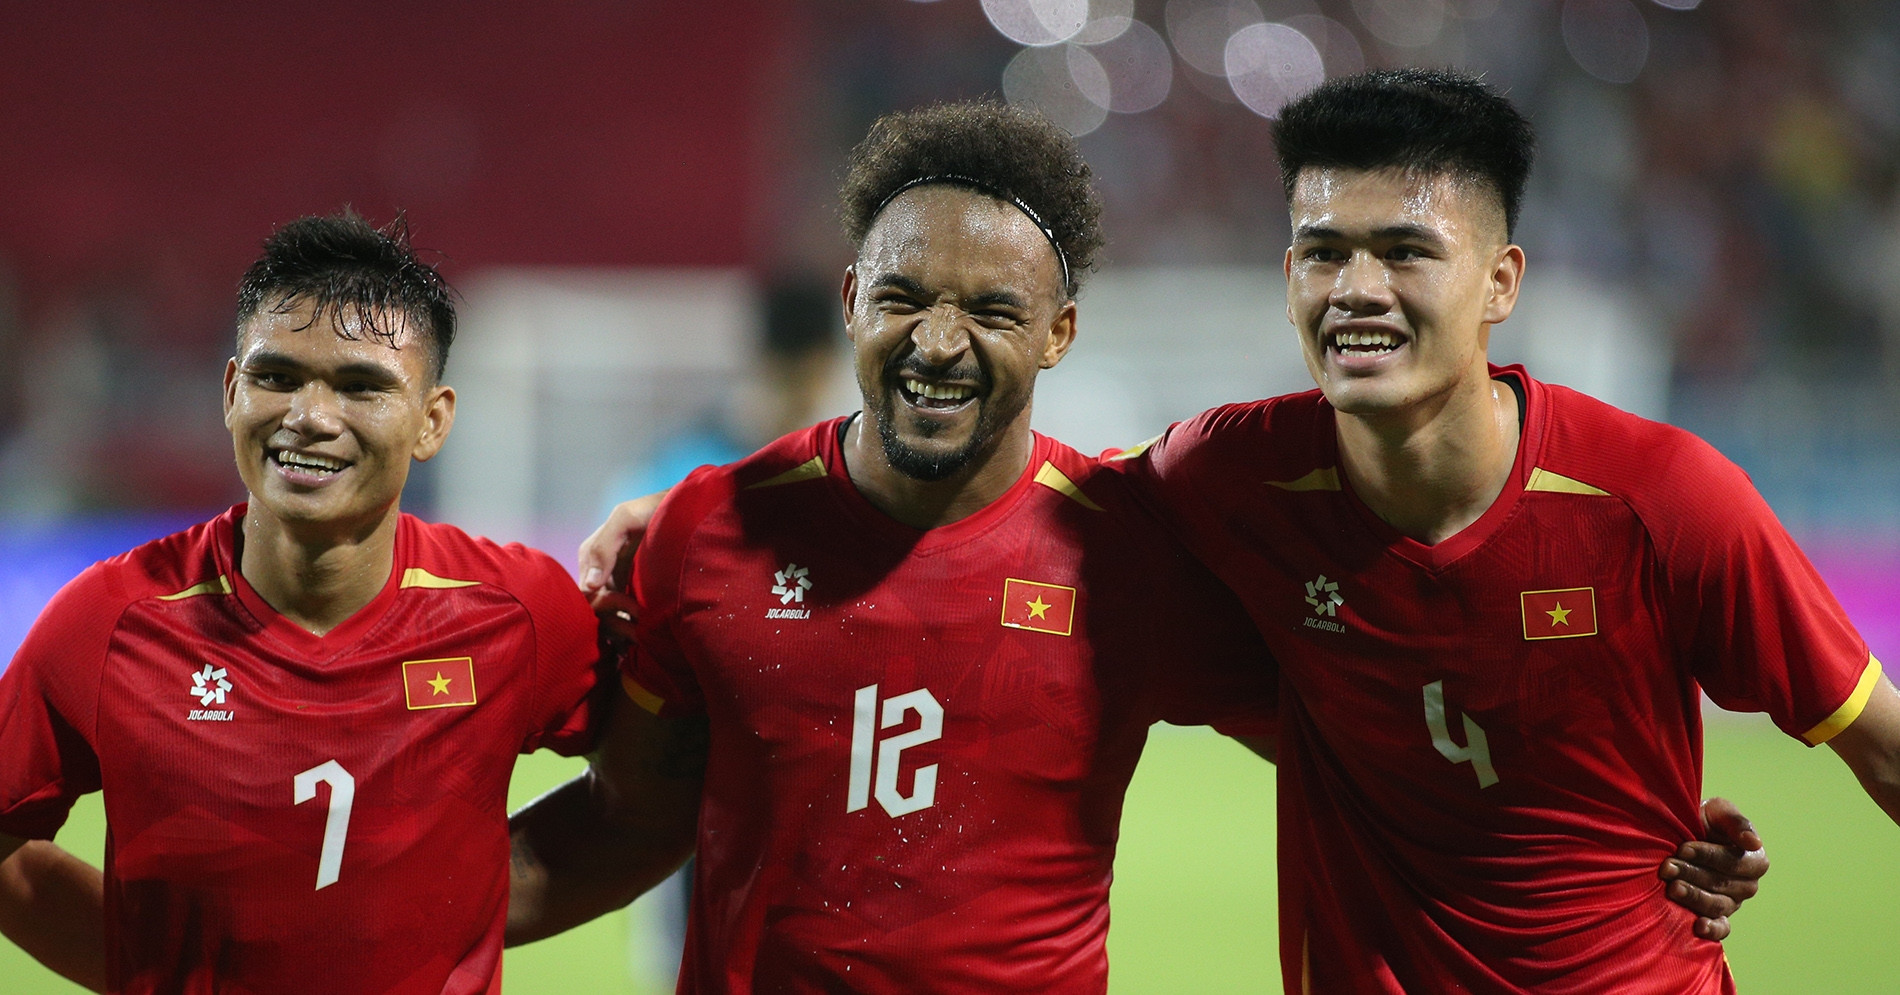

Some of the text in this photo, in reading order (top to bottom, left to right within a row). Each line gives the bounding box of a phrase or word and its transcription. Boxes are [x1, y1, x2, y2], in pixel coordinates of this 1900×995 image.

[765, 608, 811, 620] JOGARBOLA
[1303, 616, 1346, 634] JOGARBOLA
[187, 709, 235, 721] JOGARBOLA
[1422, 680, 1499, 789] 4
[847, 684, 944, 818] 12
[293, 760, 355, 890] 7
